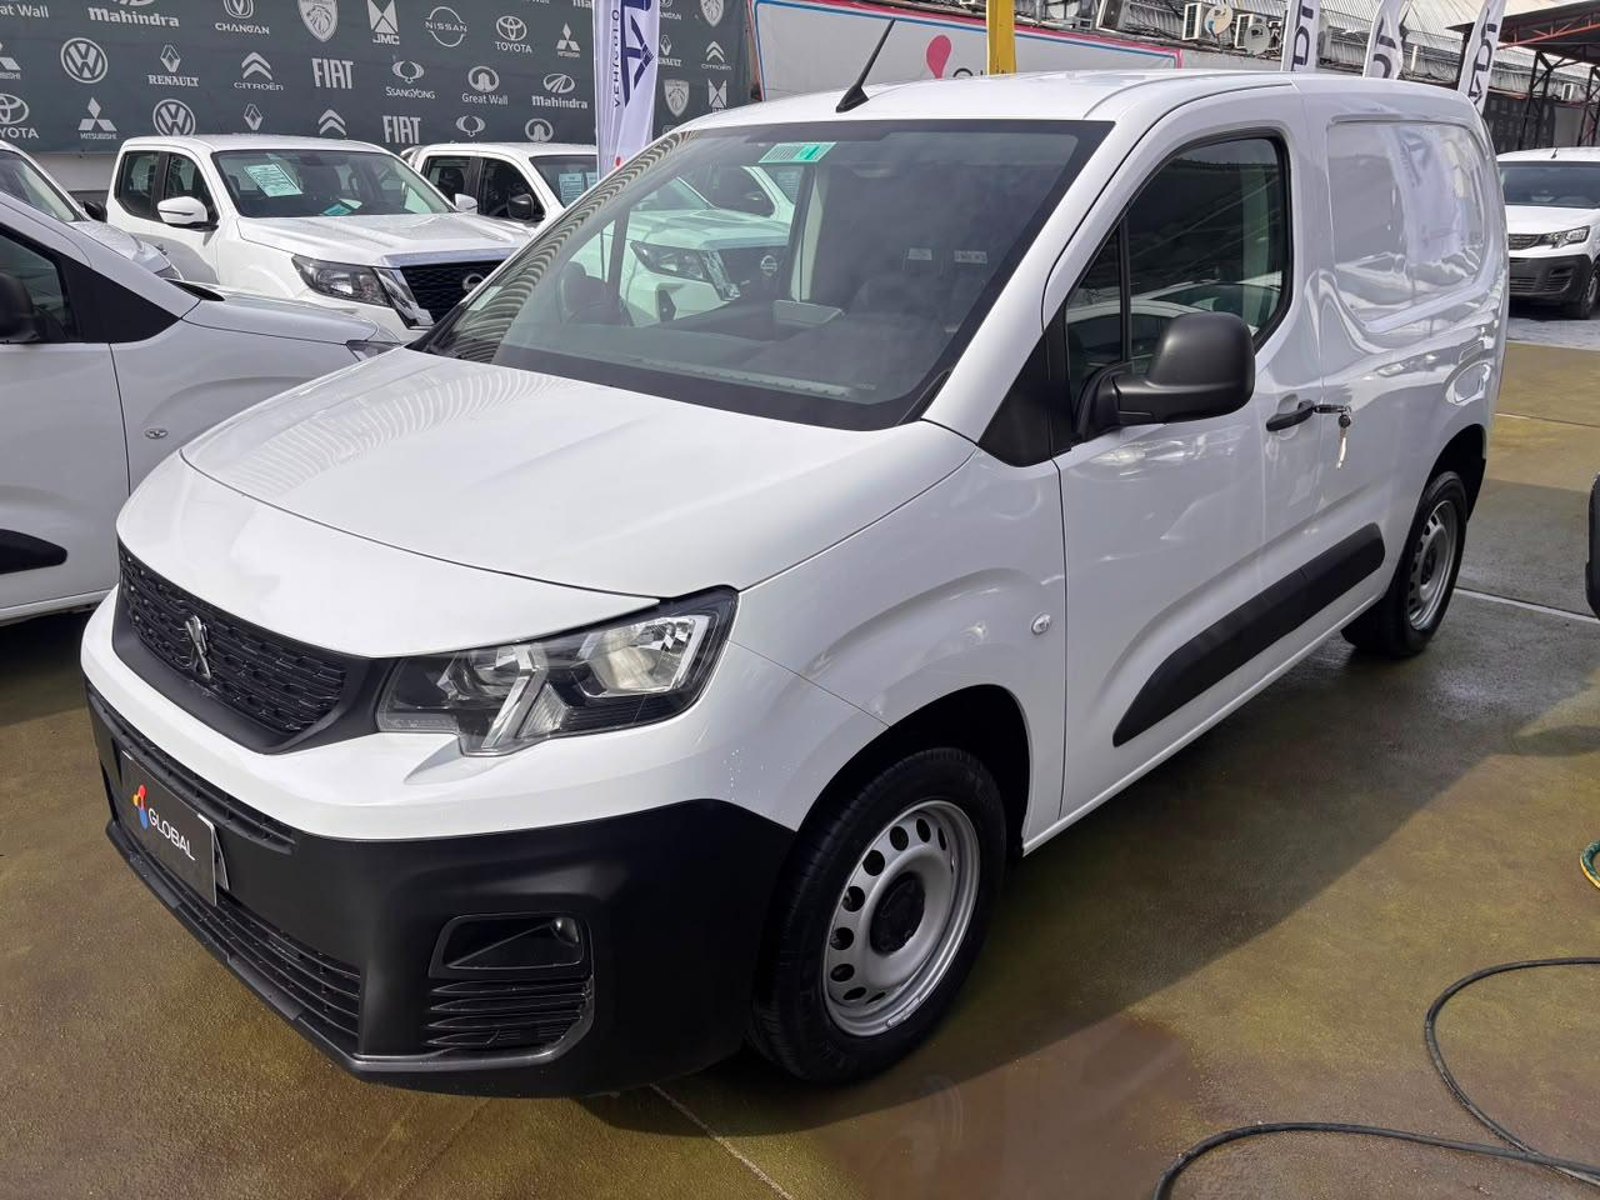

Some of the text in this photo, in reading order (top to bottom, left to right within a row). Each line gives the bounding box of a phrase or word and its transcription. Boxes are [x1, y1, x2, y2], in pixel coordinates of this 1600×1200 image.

[17, 4, 50, 18] Wall
[215, 22, 271, 35] CHANGAN
[425, 21, 468, 33] NISSAN
[373, 34, 400, 45] JMC
[495, 41, 533, 54] TOYOTA
[311, 58, 354, 89] FIAT
[147, 74, 200, 87] RENAULT
[462, 93, 508, 105] Great Wall
[382, 115, 421, 145] FIAT
[148, 808, 196, 861] GLOBAL
